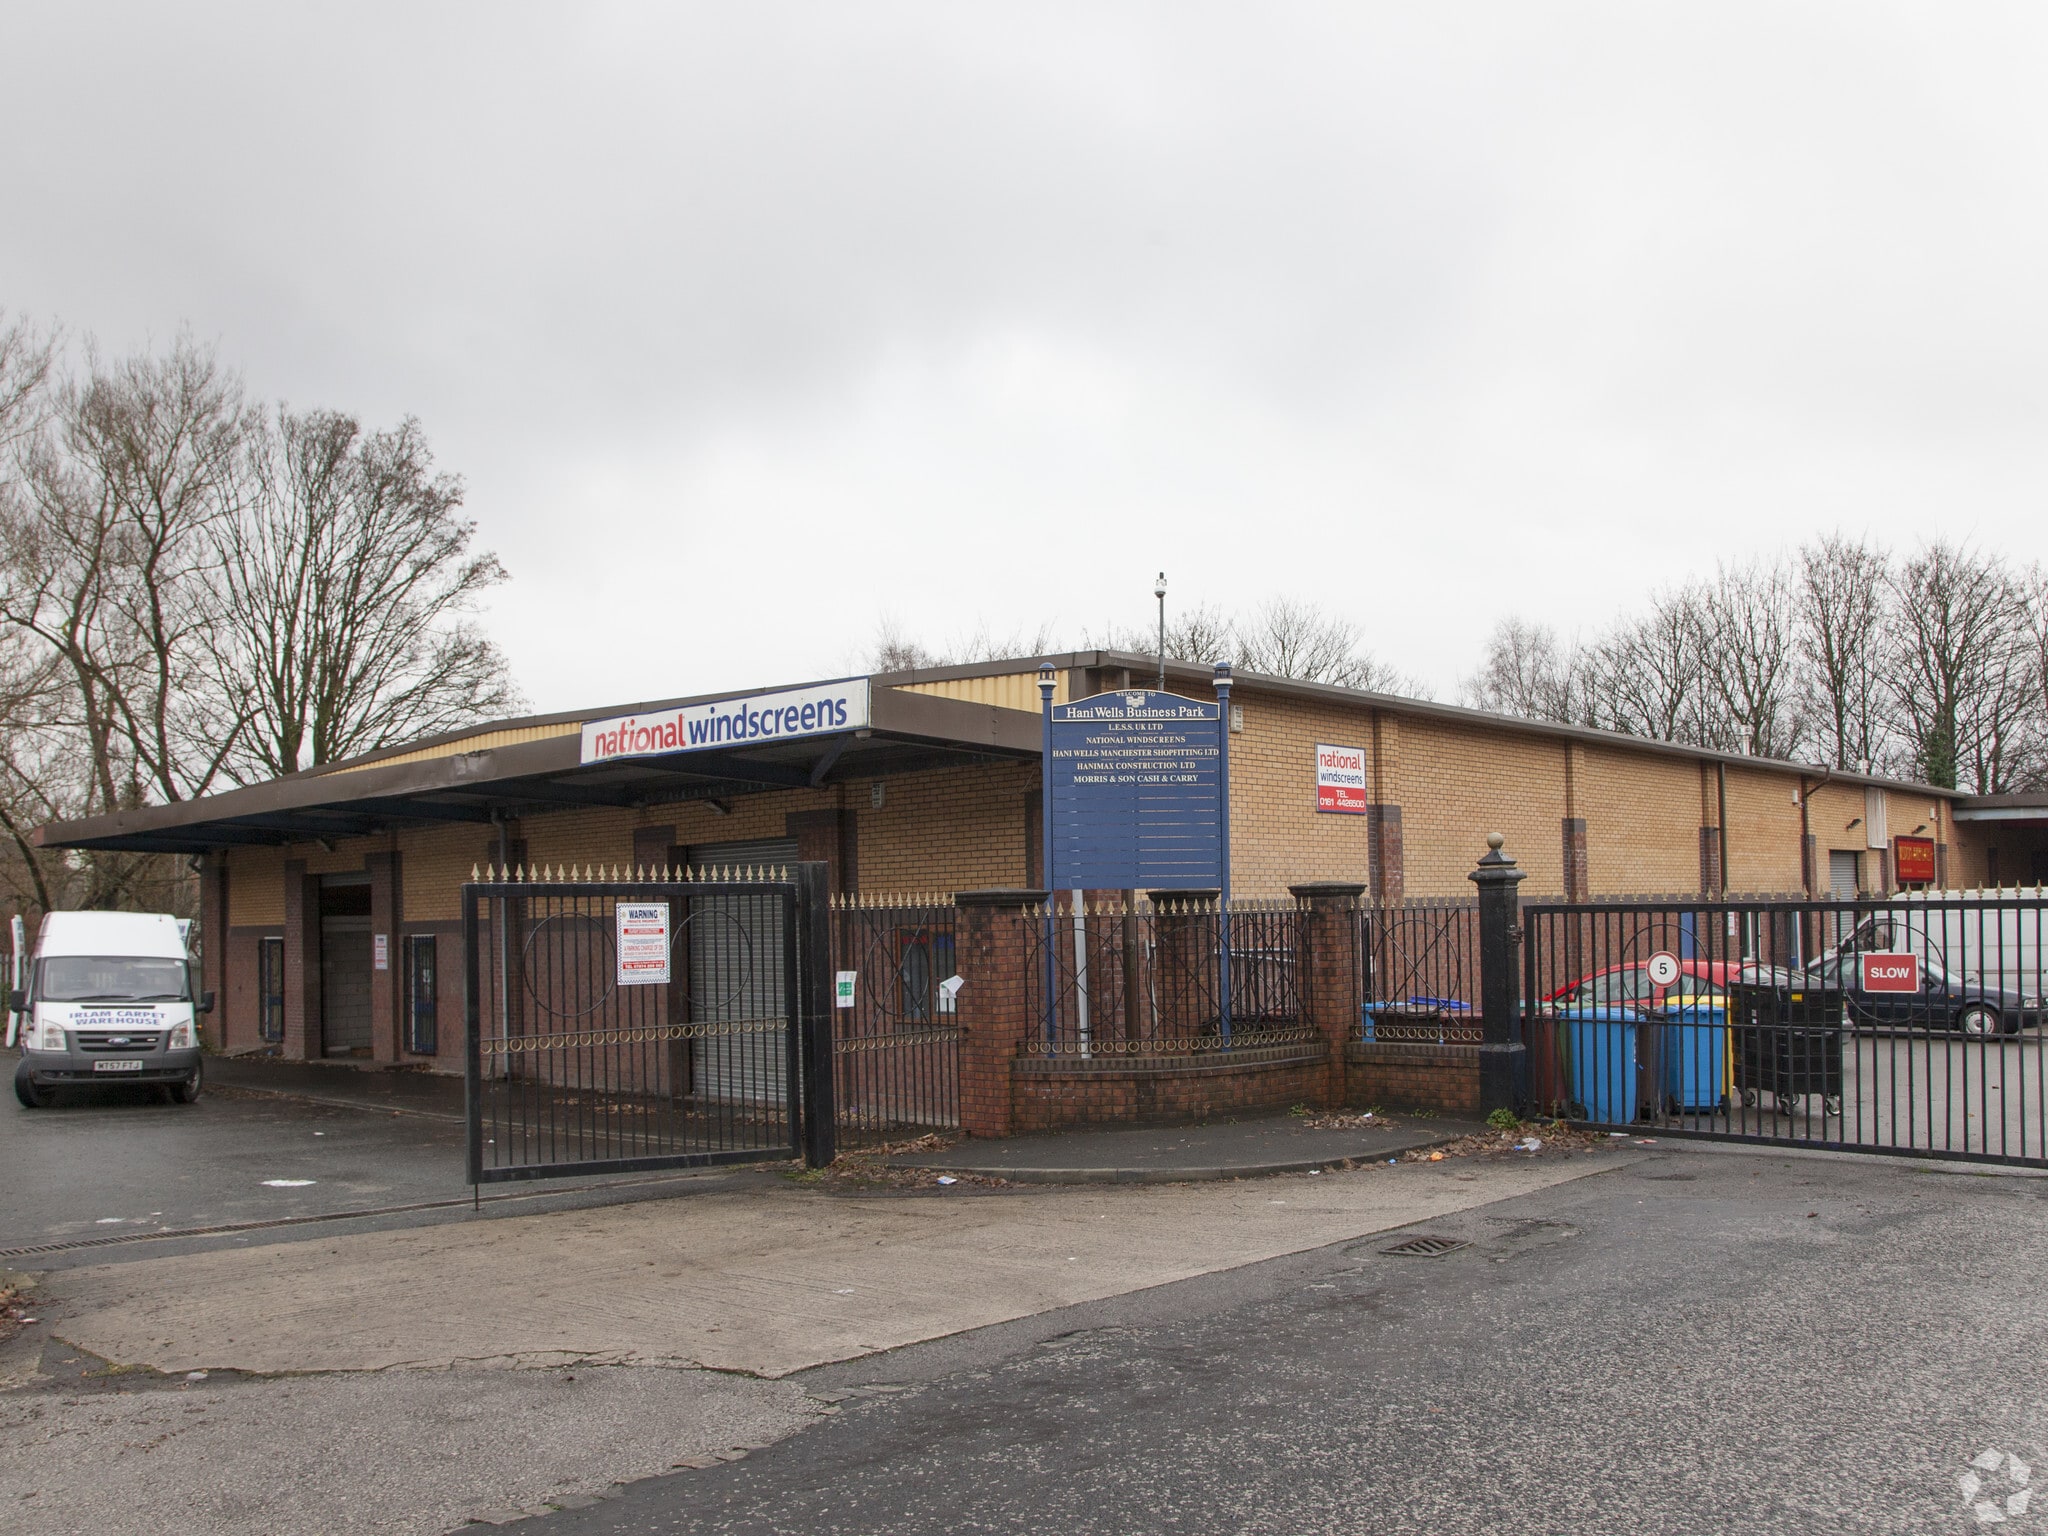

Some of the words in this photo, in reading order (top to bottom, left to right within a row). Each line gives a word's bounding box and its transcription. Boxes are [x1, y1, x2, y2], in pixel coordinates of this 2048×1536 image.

[1066, 707, 1094, 718] Hani
[1095, 707, 1124, 718] Wells
[1127, 706, 1177, 718] Business
[1178, 706, 1205, 717] Park
[595, 713, 687, 758] national
[689, 698, 848, 745] windscreens
[1135, 723, 1146, 731] UK
[1086, 736, 1125, 744] NATIONAL
[1126, 736, 1186, 744] WINDSCREENS
[1053, 749, 1072, 757] HANI
[1073, 749, 1099, 757] WELLS
[1100, 749, 1152, 757] MANCHESTER
[1153, 748, 1204, 756] SHOPFITTING
[1204, 748, 1219, 756] LTD
[1319, 750, 1362, 770] national
[1077, 762, 1114, 770] HANIMAX
[1115, 761, 1178, 770] CONSTRUCTION
[1180, 761, 1196, 769] LTD
[1073, 775, 1108, 783] MORRIS
[1109, 775, 1116, 783] &
[1117, 775, 1136, 783] SON
[1169, 774, 1199, 782] CARRY
[1320, 769, 1363, 785] windscreens
[1319, 797, 1334, 806] 0161
[628, 909, 658, 919] WARNING
[1659, 962, 1667, 975] 5
[1870, 966, 1910, 979] SLOW
[69, 1010, 112, 1019] IRLAM
[116, 1010, 167, 1019] CARPET
[75, 1017, 161, 1026] WAREHOUSE
